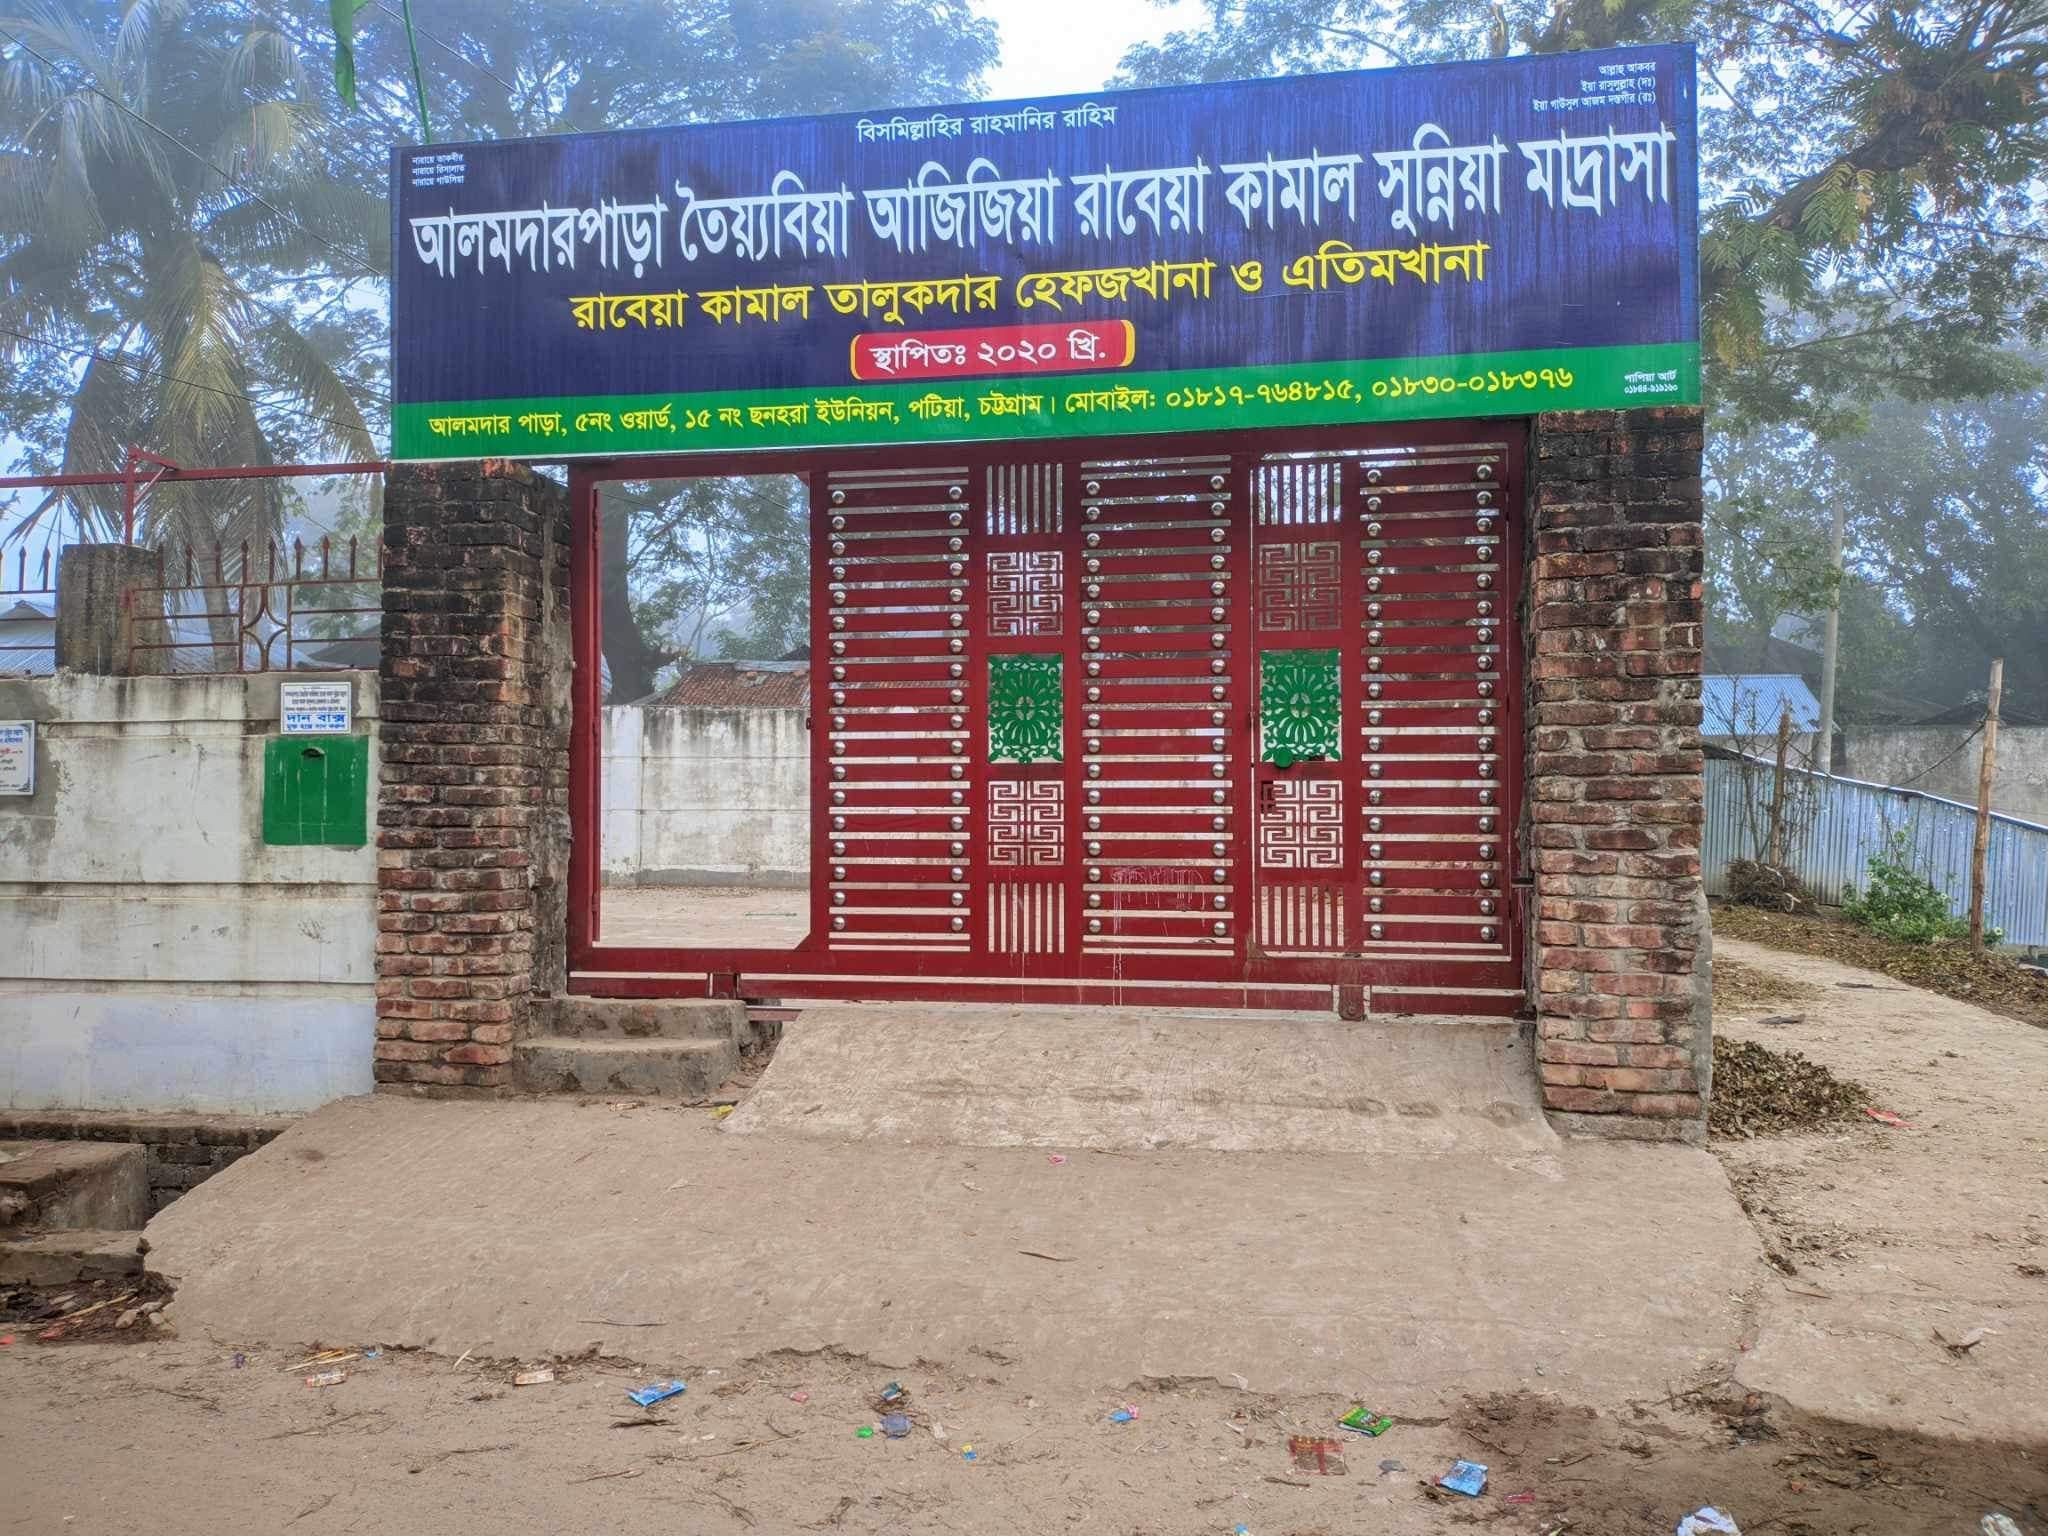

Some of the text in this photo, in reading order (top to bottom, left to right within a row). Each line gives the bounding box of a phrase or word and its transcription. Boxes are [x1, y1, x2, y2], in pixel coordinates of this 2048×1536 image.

[856, 102, 1118, 144] বিসমিল্লাহির রাহমানির রাহিম
[409, 194, 668, 278] আলমদারপাড়া
[863, 158, 1062, 254] আজিজিয়া
[1071, 156, 1211, 240] রাবেয়া
[1220, 148, 1363, 229] কামাল
[1372, 123, 1509, 236] সুন্নিয়া
[1517, 122, 1676, 216] মাদ্রাসা
[570, 240, 1490, 329] রাবেয়া কামাল তালুকদার হেফজখানা ও এতিমখানা
[870, 339, 965, 373] স্থাপিতঃ
[978, 341, 1056, 365] ২০২০
[429, 415, 511, 436] আলমদার
[519, 413, 567, 436] পাড়া,
[576, 413, 613, 431] ৫নং
[620, 404, 675, 432] ওয়ার্ড,
[686, 410, 711, 428] ১৫
[718, 408, 742, 426] নং
[748, 403, 809, 426] ছনহরা
[815, 397, 899, 424] ইউনিয়ন,
[909, 394, 969, 421] পটিয়া,
[1066, 386, 1155, 412] মোবাইল:
[1167, 380, 1361, 407] ০১৮১৭-৭৬৪৮১৫,
[1373, 368, 1572, 397] ০১৮৩০-০১৮৩৭৬
